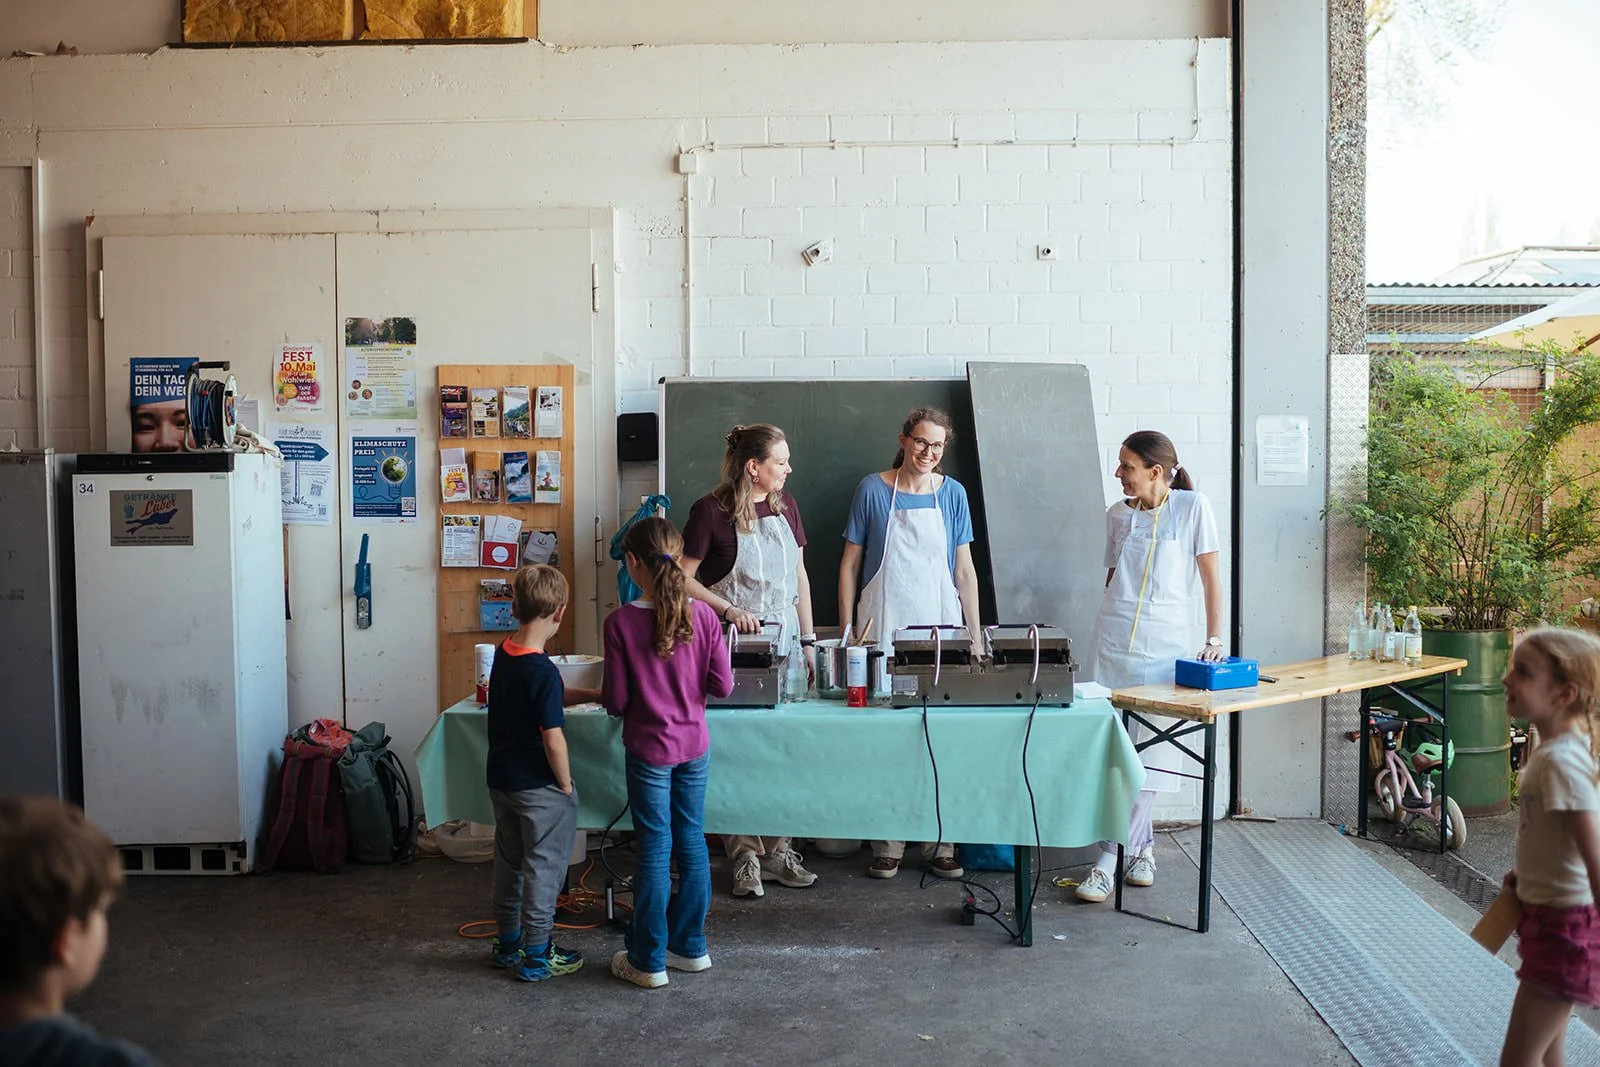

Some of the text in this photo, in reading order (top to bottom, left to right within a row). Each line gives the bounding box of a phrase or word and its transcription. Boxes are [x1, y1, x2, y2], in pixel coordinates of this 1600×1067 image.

[283, 351, 313, 361] FEST
[135, 374, 186, 385] DEIN TAG
[135, 386, 161, 396] DEIN
[79, 483, 94, 494] 34
